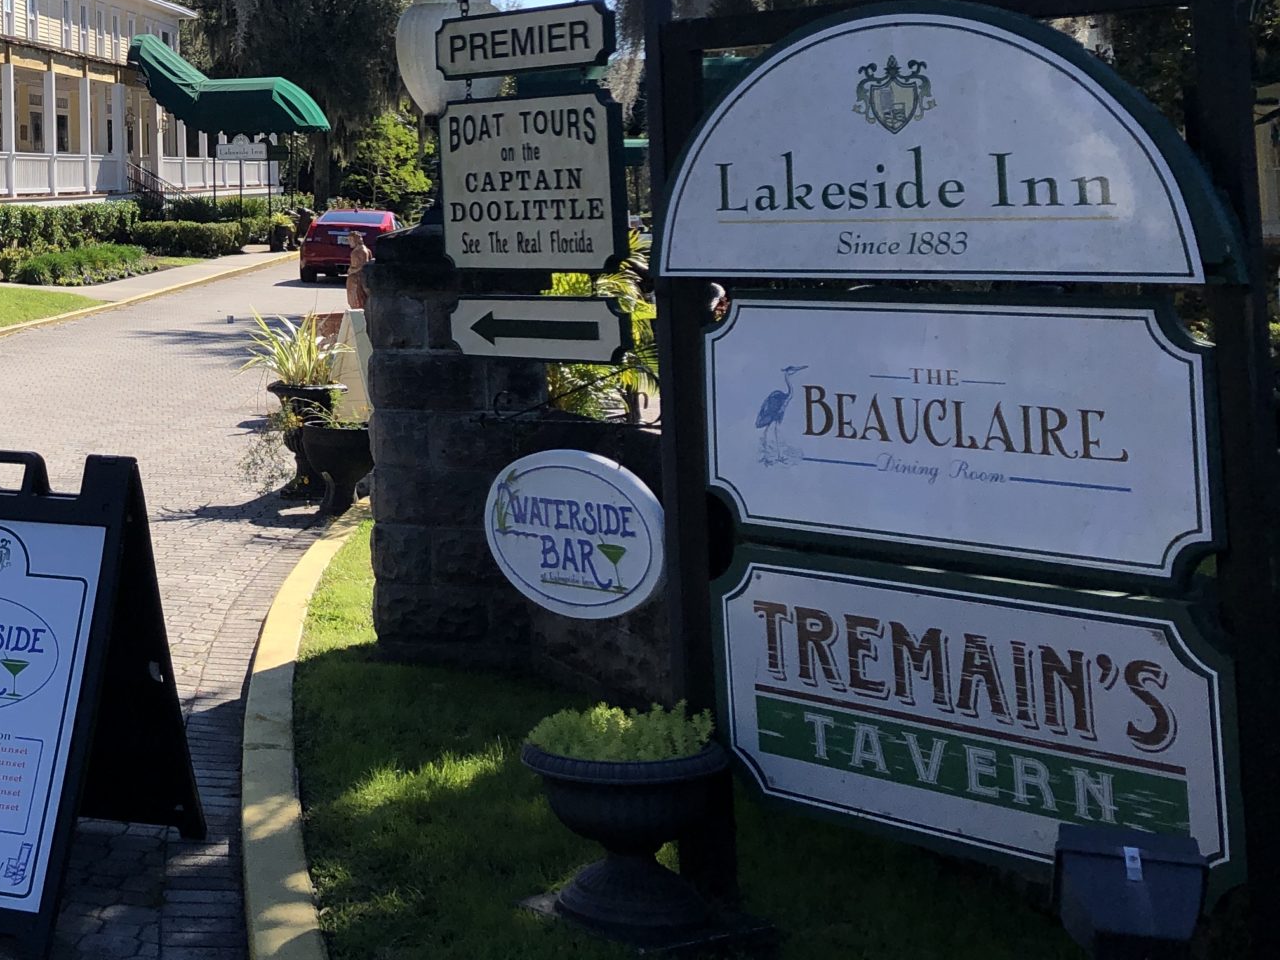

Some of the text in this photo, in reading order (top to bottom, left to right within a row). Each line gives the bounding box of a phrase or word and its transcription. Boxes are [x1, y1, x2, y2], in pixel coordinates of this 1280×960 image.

[449, 19, 591, 63] PREMIER
[448, 106, 597, 153] BOAT TOURS
[500, 142, 540, 162] on the
[465, 167, 583, 193] CAPTAIN
[715, 145, 1118, 213] Lakeside Inn
[450, 198, 605, 223] DOOLITTLE
[461, 230, 594, 255] See The Real Florida
[835, 230, 969, 257] Since 1883
[908, 367, 960, 387] THE
[801, 383, 1130, 463] BEAUCLAIRE
[875, 452, 1007, 485] Dining Room
[500, 486, 637, 537] WATERSIDE
[540, 534, 612, 589] BAR
[753, 599, 1178, 753] TREMAIN'S
[803, 709, 1119, 824] TAVERN
